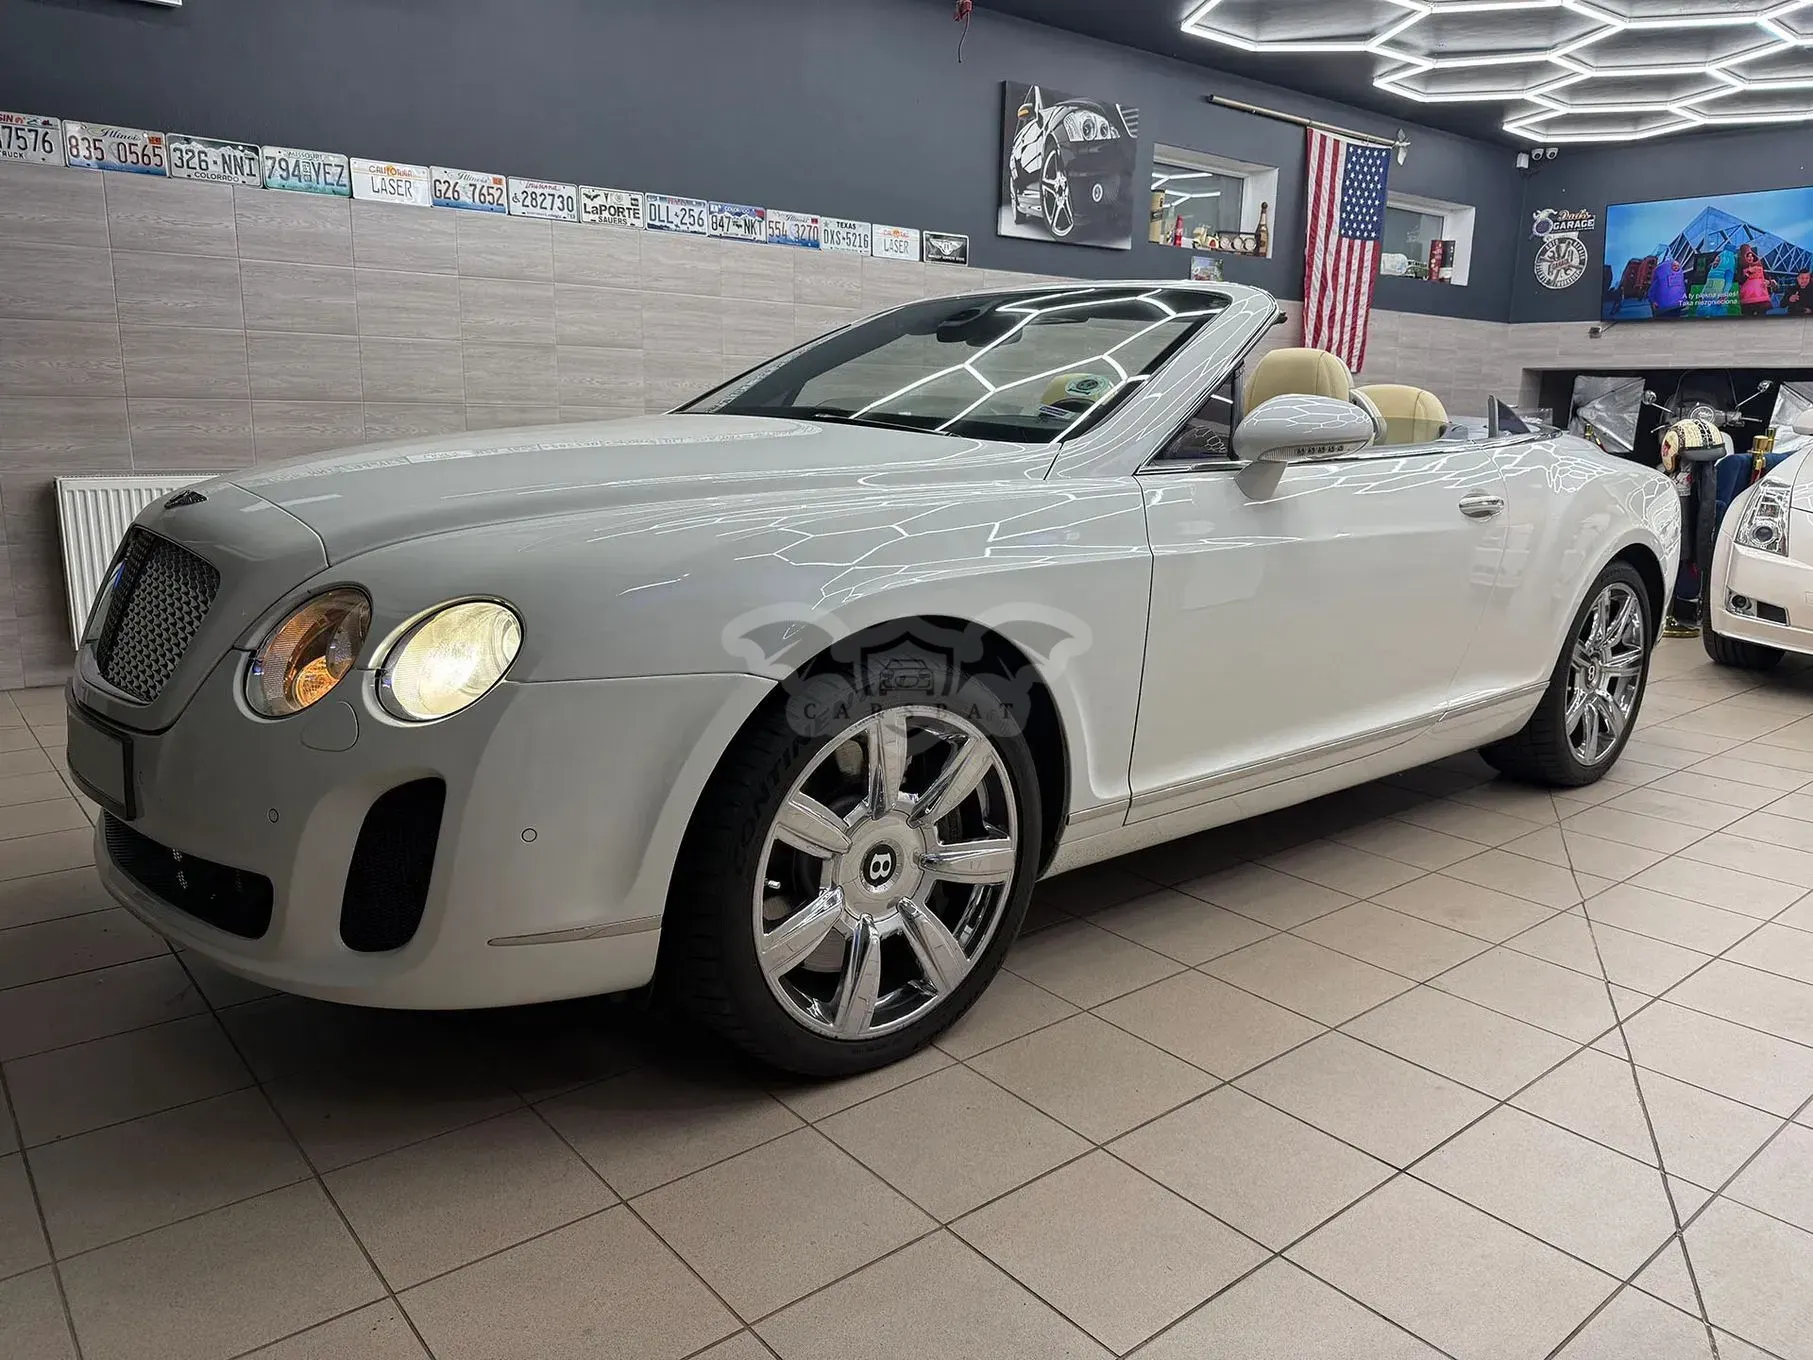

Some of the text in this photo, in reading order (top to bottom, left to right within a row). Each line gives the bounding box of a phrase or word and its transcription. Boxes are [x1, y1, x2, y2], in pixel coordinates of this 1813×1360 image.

[0, 125, 54, 154] 7576
[0, 150, 25, 159] RUCK
[194, 171, 239, 183] COLORADO
[371, 176, 412, 198] LASER
[469, 184, 504, 206] 7652
[521, 190, 574, 212] 282730
[583, 203, 640, 219] LaPORTE
[1553, 219, 1594, 230] GARAGE
[883, 239, 909, 254] LASER
